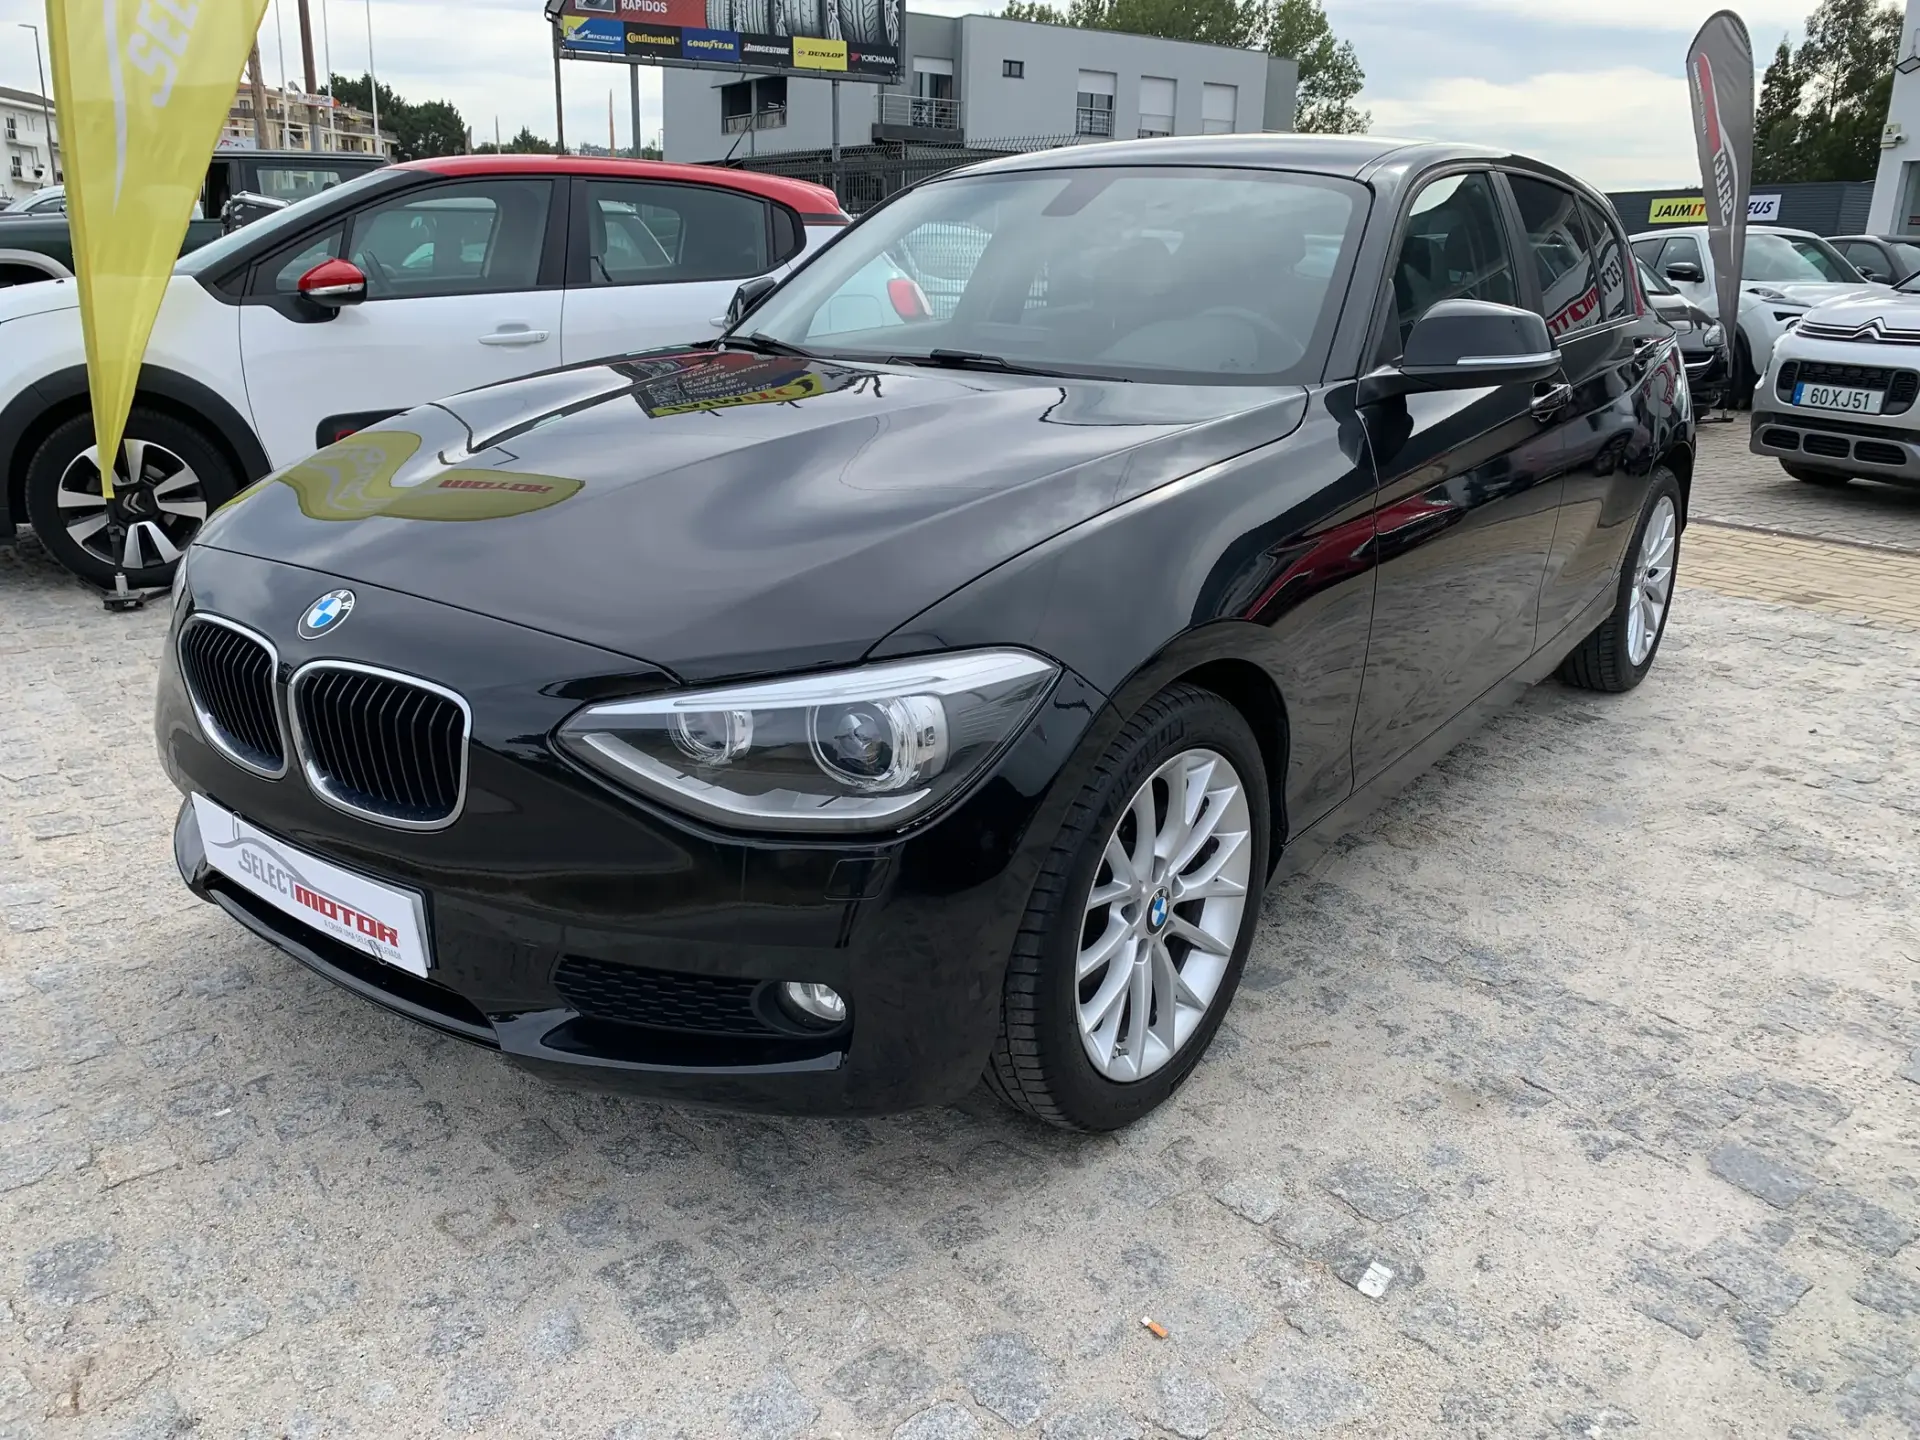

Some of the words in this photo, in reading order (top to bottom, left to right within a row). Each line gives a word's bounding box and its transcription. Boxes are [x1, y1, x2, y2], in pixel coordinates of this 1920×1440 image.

[586, 34, 621, 42] MICHELIN
[626, 32, 675, 46] Continental
[687, 39, 735, 50] GOODYEAR
[743, 43, 790, 55] BRIDGESTONE
[807, 50, 844, 59] DUNLOP
[860, 54, 896, 64] YOKOHAMA
[1654, 203, 1706, 217] JAIMIT
[1747, 201, 1774, 215] EUS
[1810, 387, 1870, 411] 60XJ51
